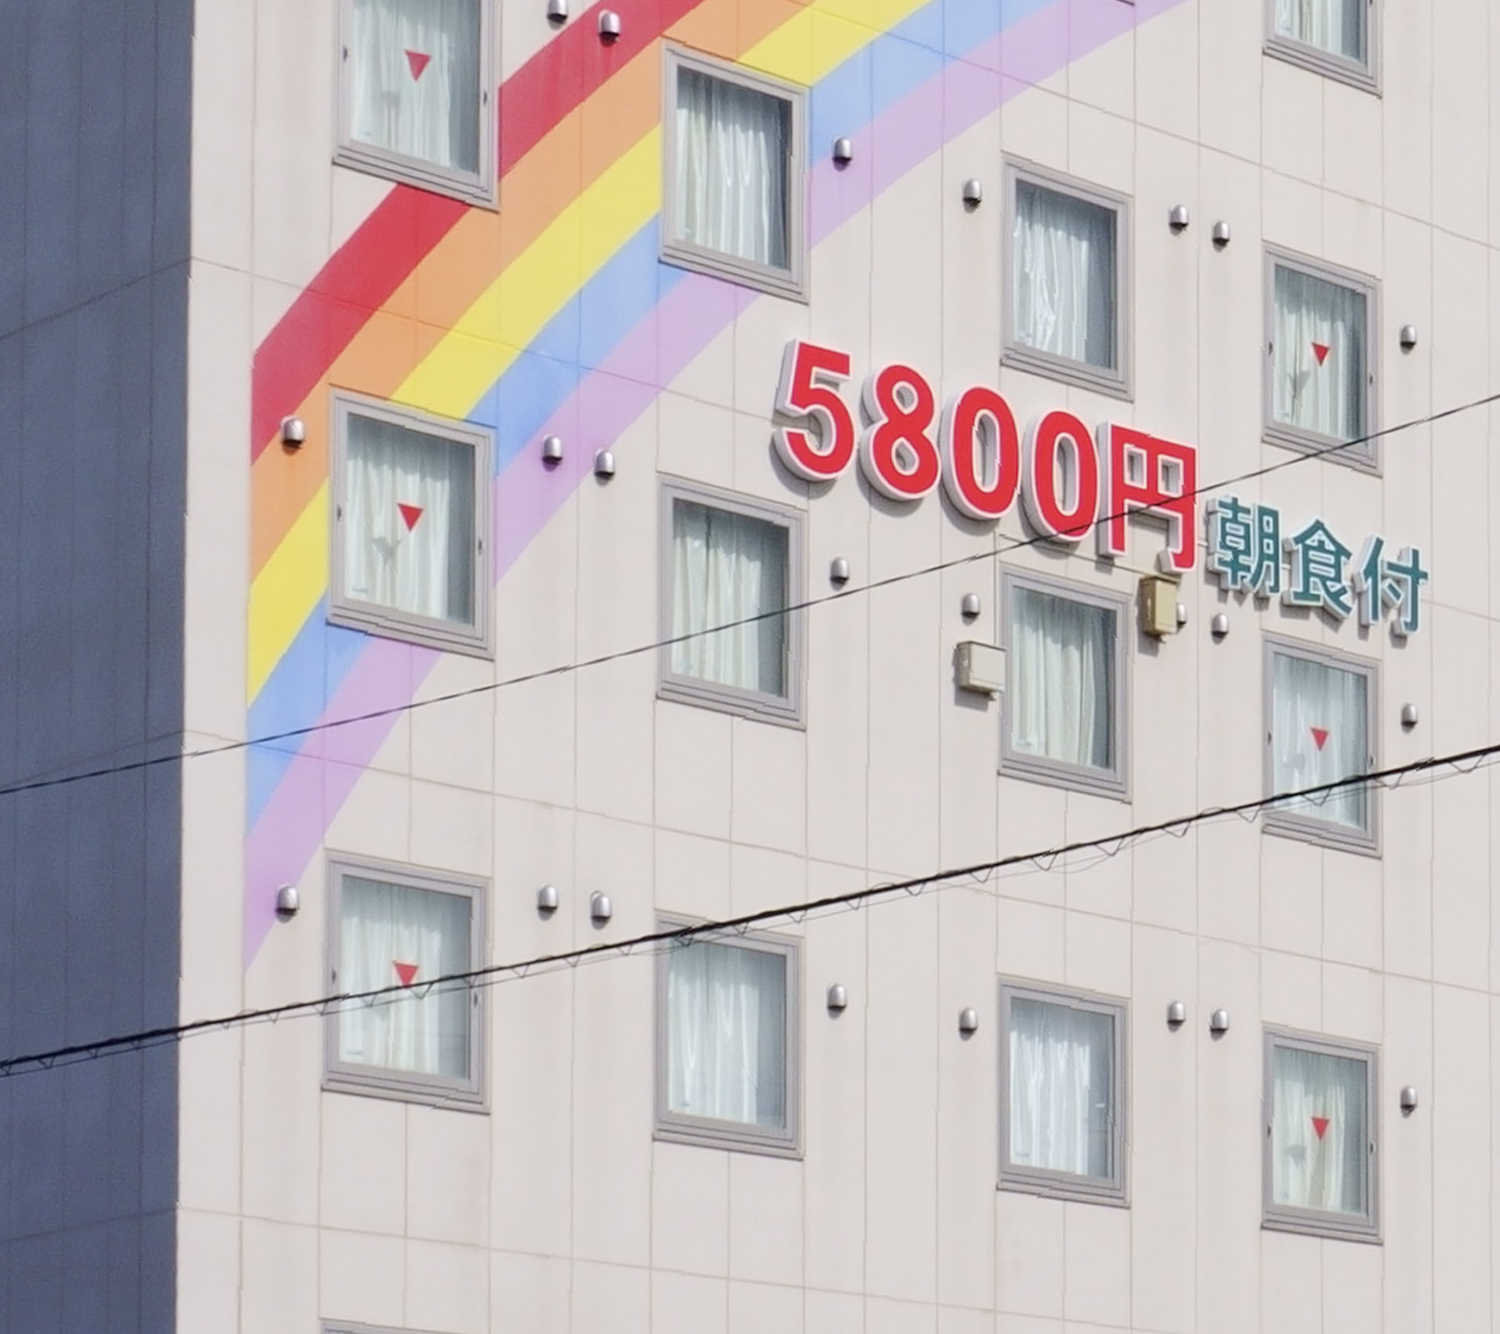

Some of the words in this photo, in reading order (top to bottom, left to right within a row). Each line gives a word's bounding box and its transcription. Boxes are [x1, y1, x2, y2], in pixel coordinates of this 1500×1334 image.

[775, 339, 1199, 573] 5800円
[1208, 495, 1429, 634] 朝食付
